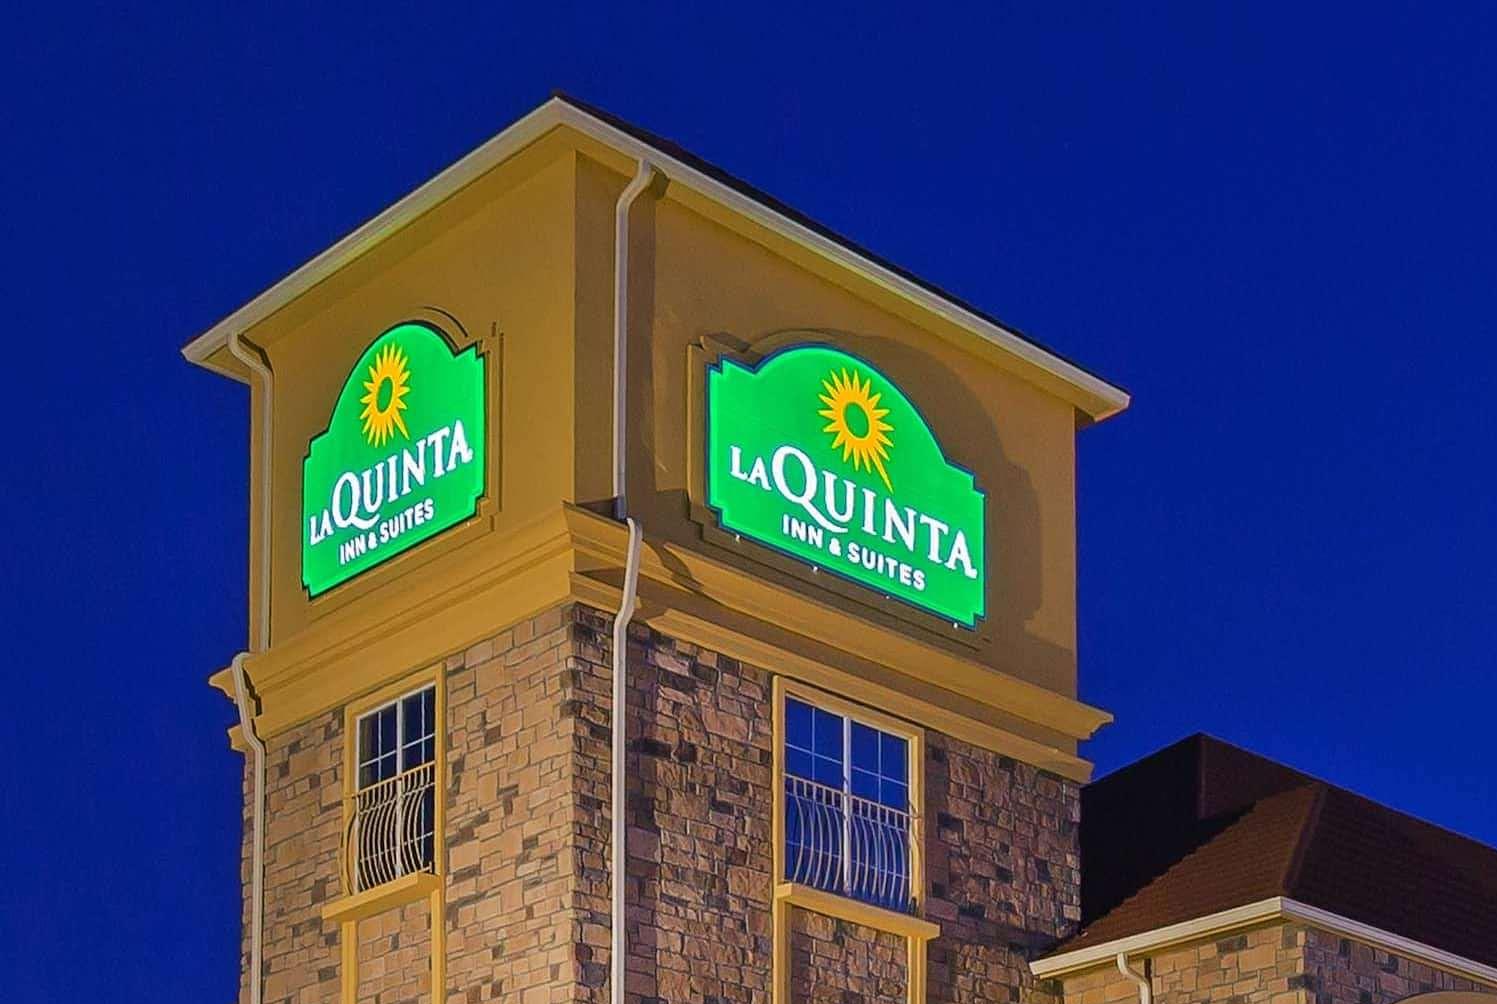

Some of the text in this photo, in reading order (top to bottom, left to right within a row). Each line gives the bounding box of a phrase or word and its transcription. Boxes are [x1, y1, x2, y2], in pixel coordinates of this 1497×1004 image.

[309, 419, 473, 546] LA QUINTA
[340, 498, 434, 565] INN & SUITES
[730, 445, 977, 579] LA QUINTA
[782, 513, 926, 591] INN & SUITES
